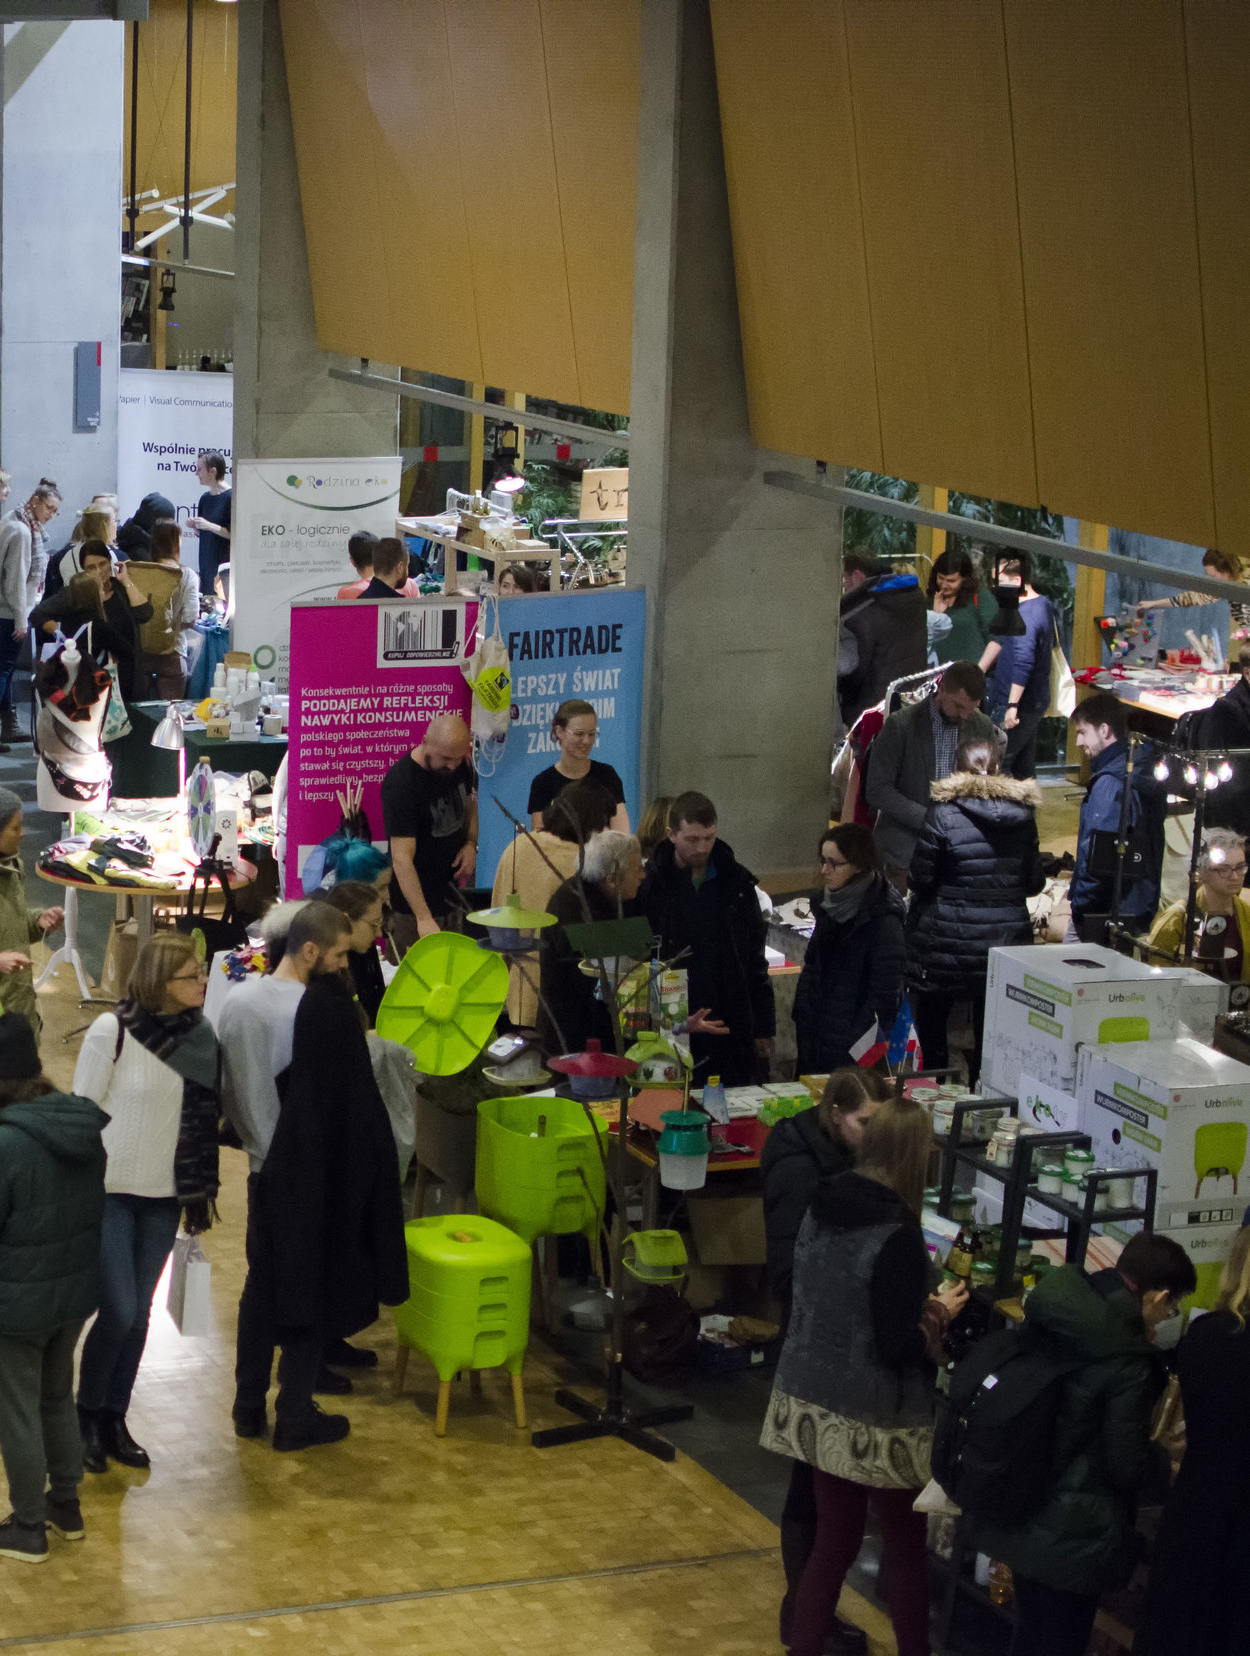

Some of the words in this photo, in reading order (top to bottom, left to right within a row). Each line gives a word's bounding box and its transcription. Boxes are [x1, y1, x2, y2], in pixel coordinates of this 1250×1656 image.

[149, 396, 172, 406] Visual
[142, 442, 196, 456] Wspólnie
[157, 462, 171, 471] na
[174, 460, 197, 472] Twó
[261, 525, 286, 536] EKO
[508, 624, 624, 662] FAIRTRADE
[573, 666, 622, 693] ŚWIAT
[301, 686, 370, 698] Konsekwentnie
[376, 686, 388, 694] na
[389, 684, 414, 694] różne
[416, 684, 454, 695] sposoby
[301, 698, 380, 712] PODDAJEMY
[383, 695, 448, 710] REFLEKSJI
[300, 713, 354, 727] NAWYKI
[300, 732, 344, 744] polskiego
[346, 728, 410, 742] społeczeństwa
[300, 749, 312, 758] po
[314, 747, 323, 756] to
[325, 746, 336, 757] by
[338, 744, 364, 754] świat,
[375, 743, 408, 755] którym
[300, 760, 330, 771] stawał
[332, 760, 344, 771] się
[346, 760, 387, 771] czystszy,
[362, 772, 386, 784] bezpi
